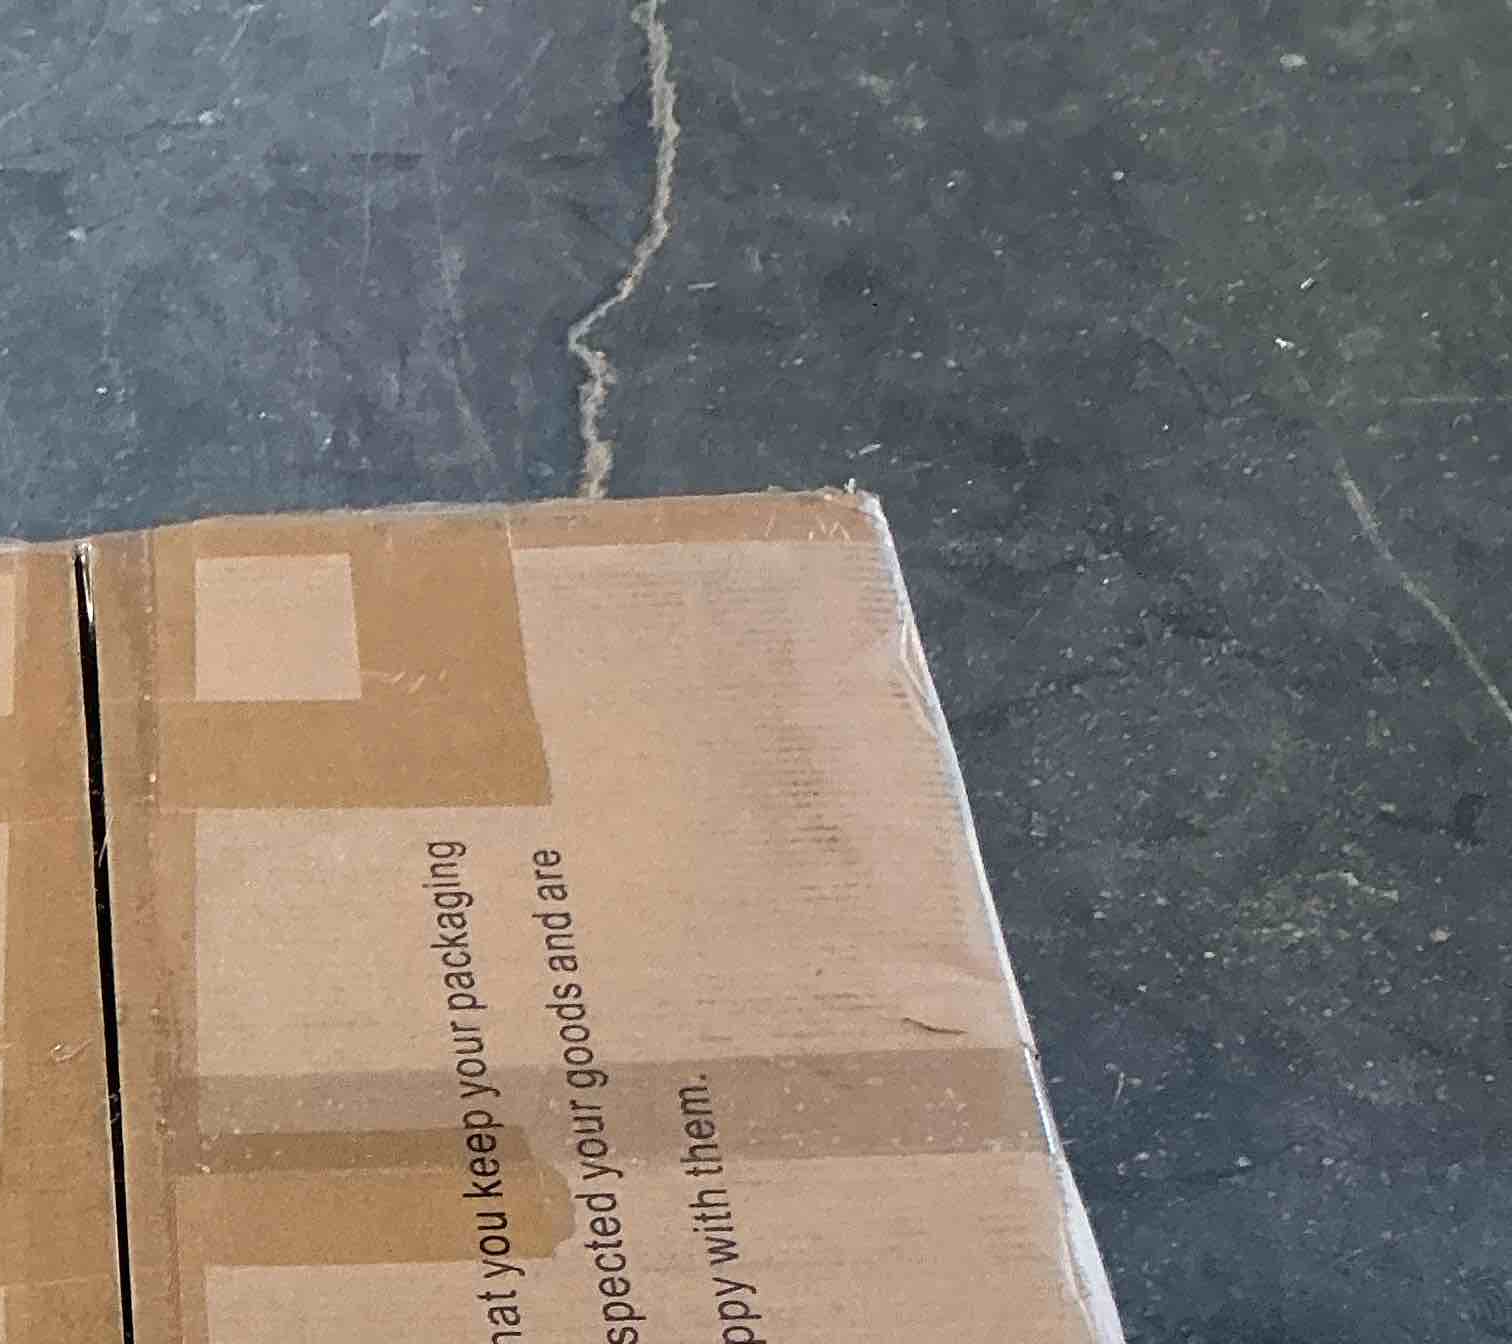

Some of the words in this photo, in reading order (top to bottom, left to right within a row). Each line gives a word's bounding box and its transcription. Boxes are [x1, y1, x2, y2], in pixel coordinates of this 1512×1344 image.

[532, 849, 568, 901] are
[422, 841, 488, 1010] packaging
[532, 912, 578, 972] and
[450, 1020, 501, 1099] your
[545, 983, 609, 1089] goods
[462, 1110, 505, 1198] keep
[569, 1099, 624, 1180] your
[678, 1074, 723, 1177] them.
[476, 1212, 525, 1278] you
[688, 1189, 739, 1266] with
